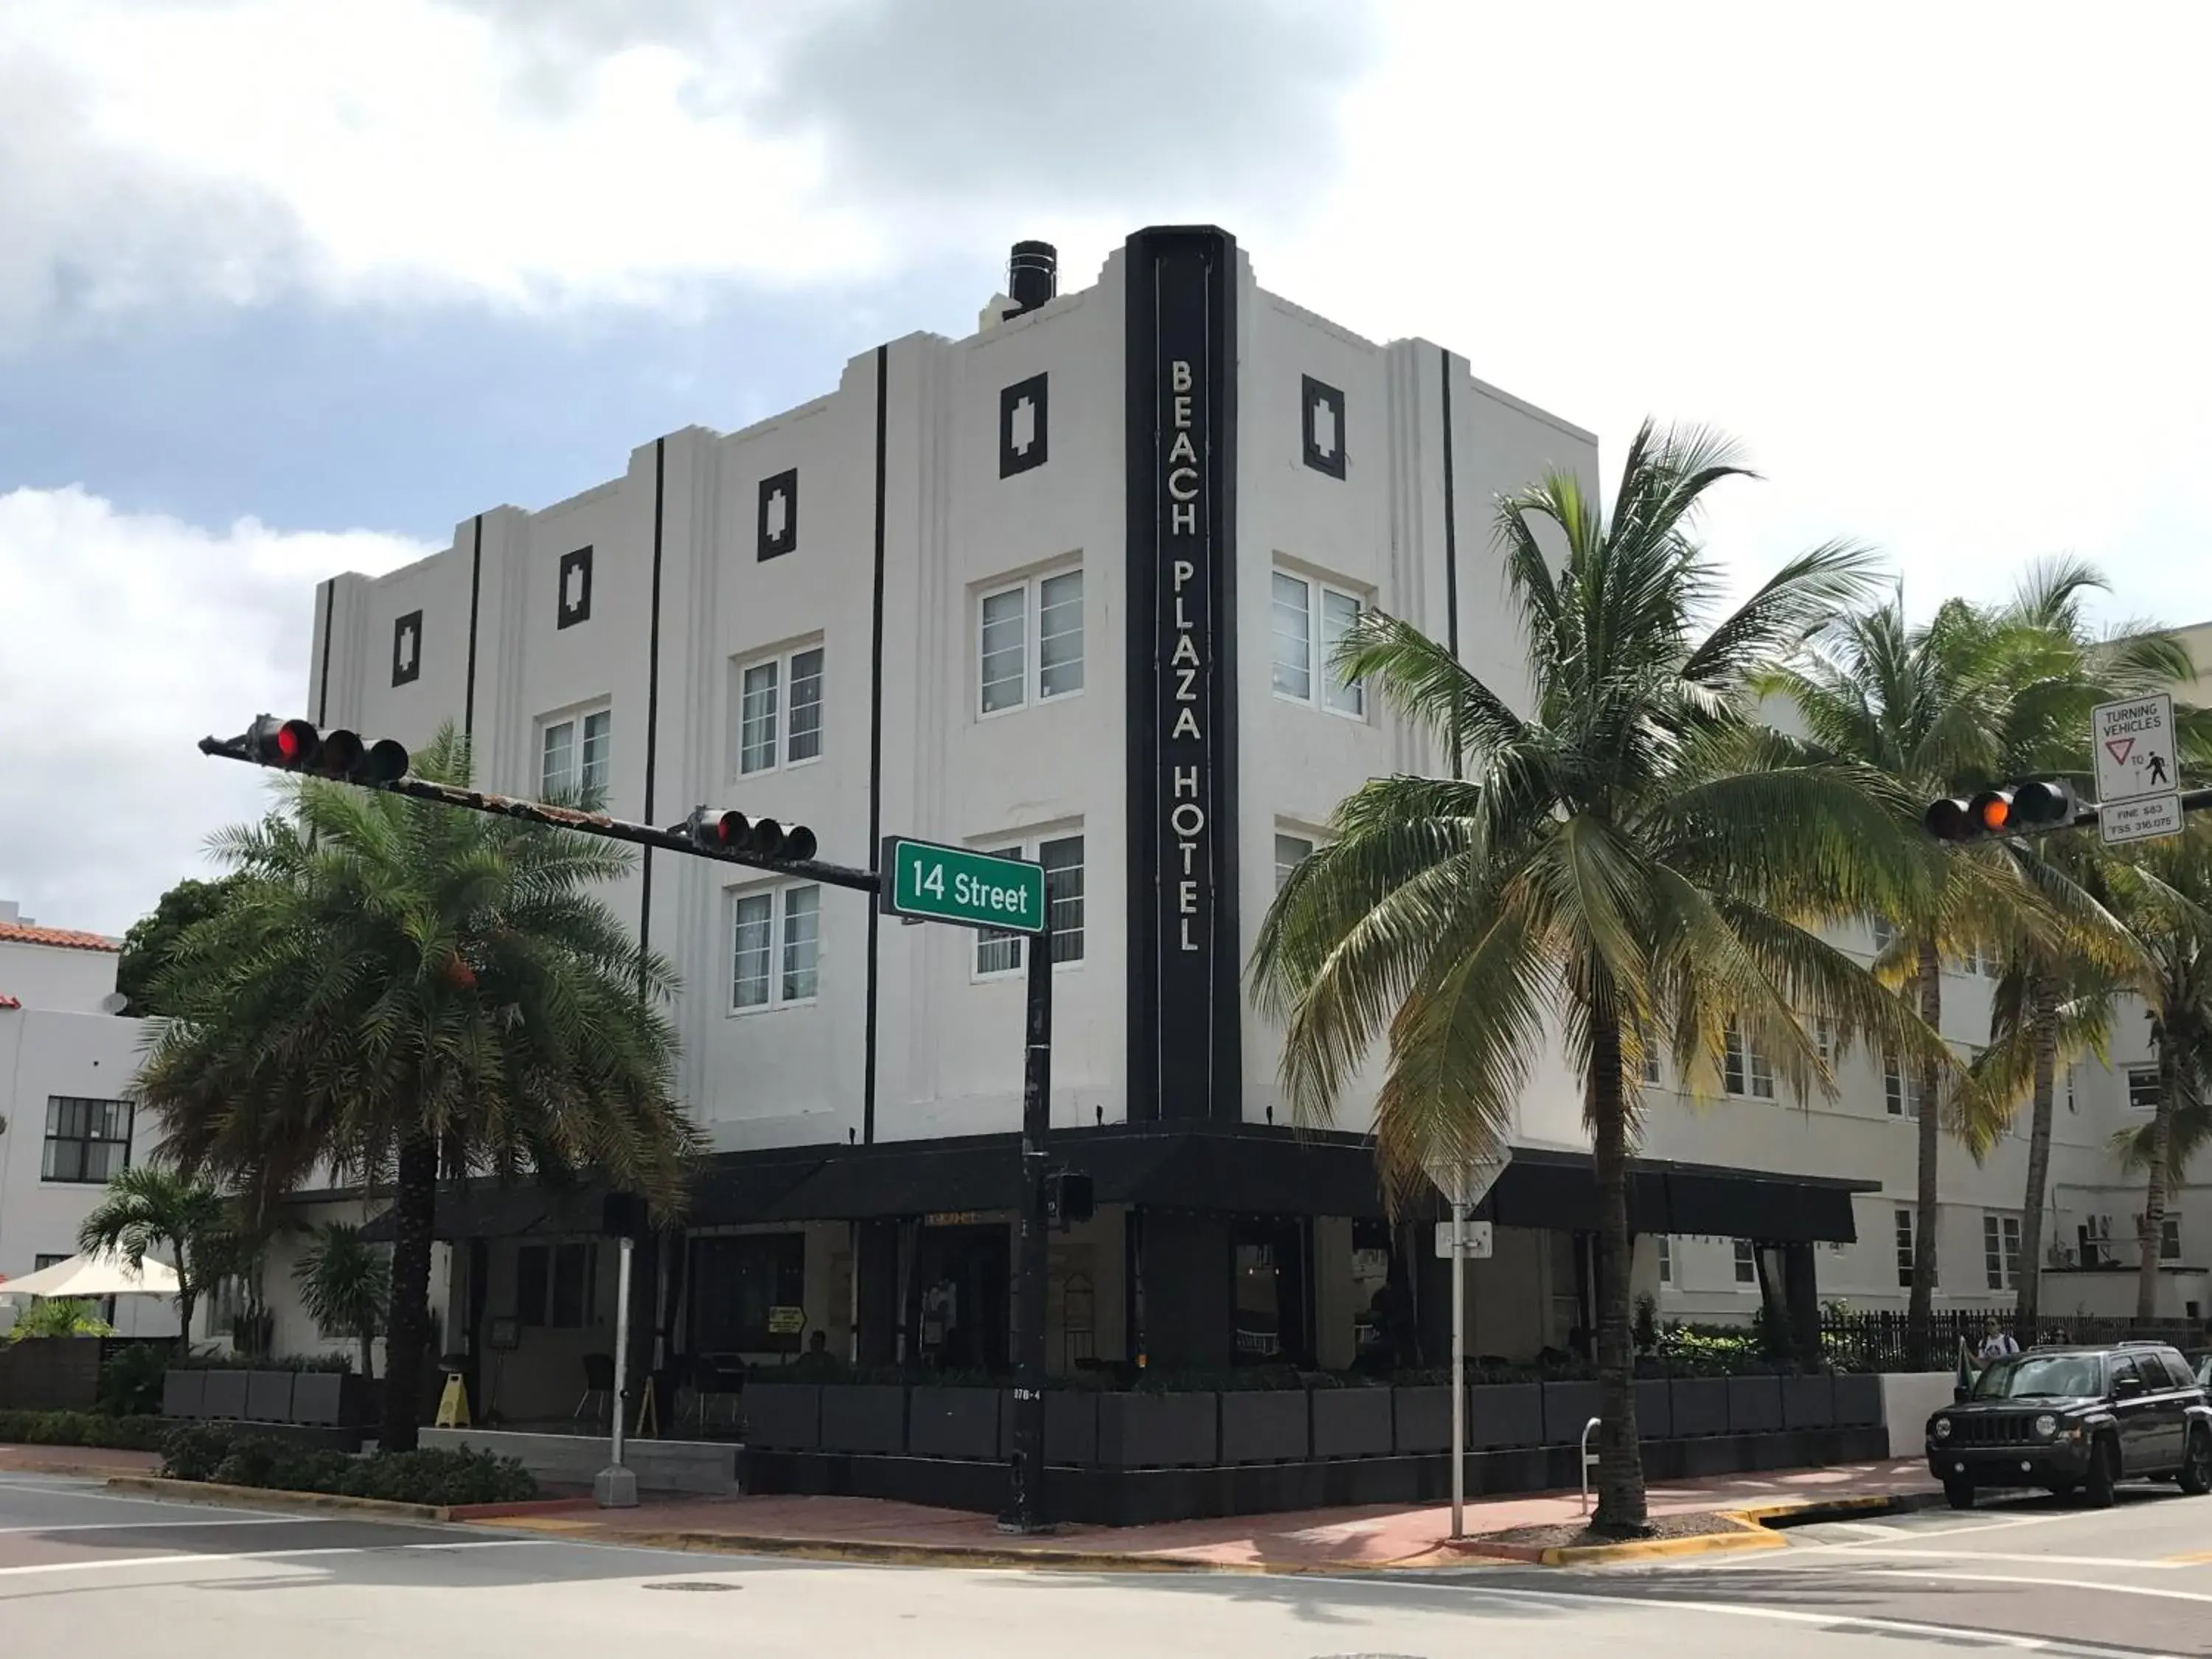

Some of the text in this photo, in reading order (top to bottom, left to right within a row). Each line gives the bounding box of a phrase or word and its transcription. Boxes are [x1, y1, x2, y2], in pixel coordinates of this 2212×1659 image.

[1169, 361, 1205, 950] BEACH PLAZA HOTEL
[2105, 703, 2158, 723] TURNING
[2103, 716, 2161, 737] VEHICLES
[2130, 755, 2144, 765] TO
[914, 860, 1028, 914] 14 Street
